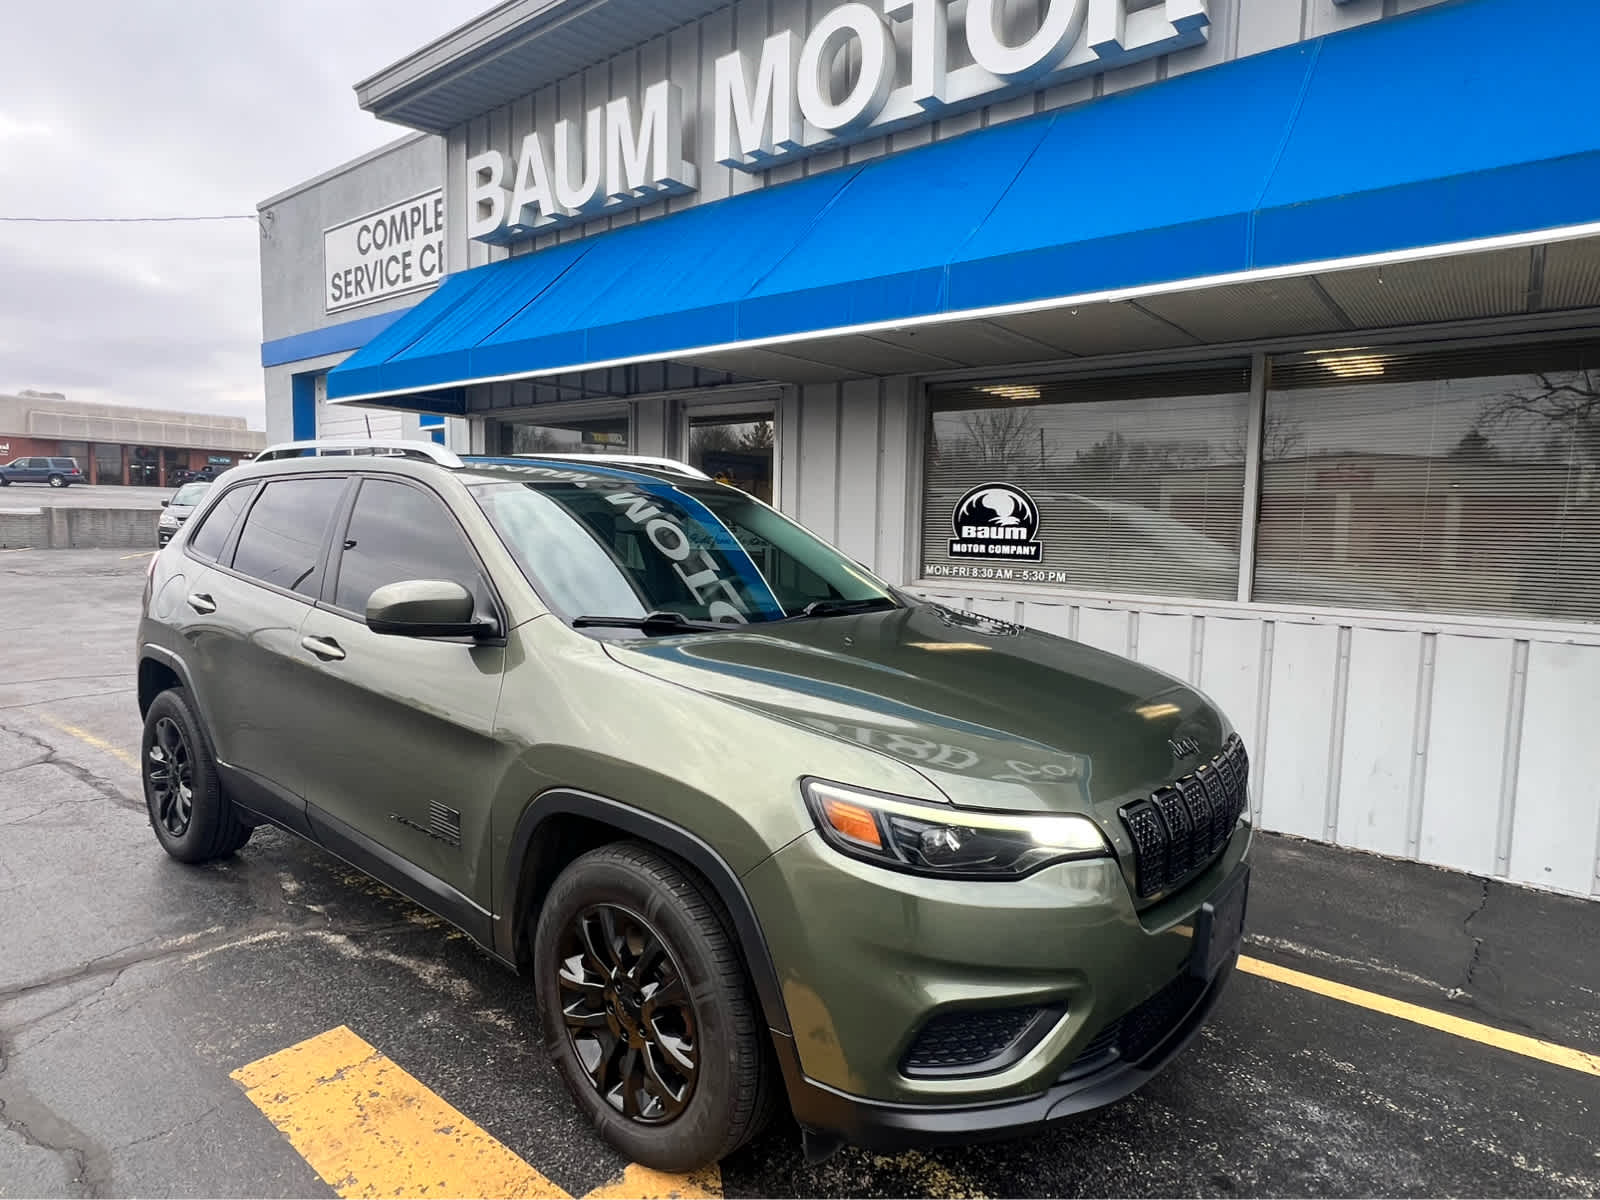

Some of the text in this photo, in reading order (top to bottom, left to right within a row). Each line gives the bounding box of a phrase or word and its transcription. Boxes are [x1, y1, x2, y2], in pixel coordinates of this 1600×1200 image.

[467, 80, 688, 242] BAUM
[331, 250, 412, 302] SERVICE
[952, 543, 1037, 556] MOTOR COMPANY
[925, 565, 970, 577] MON-FRI
[972, 567, 994, 579] 8:30
[995, 569, 1013, 580] AM
[1022, 570, 1045, 582] 5:30
[1048, 571, 1067, 583] PM
